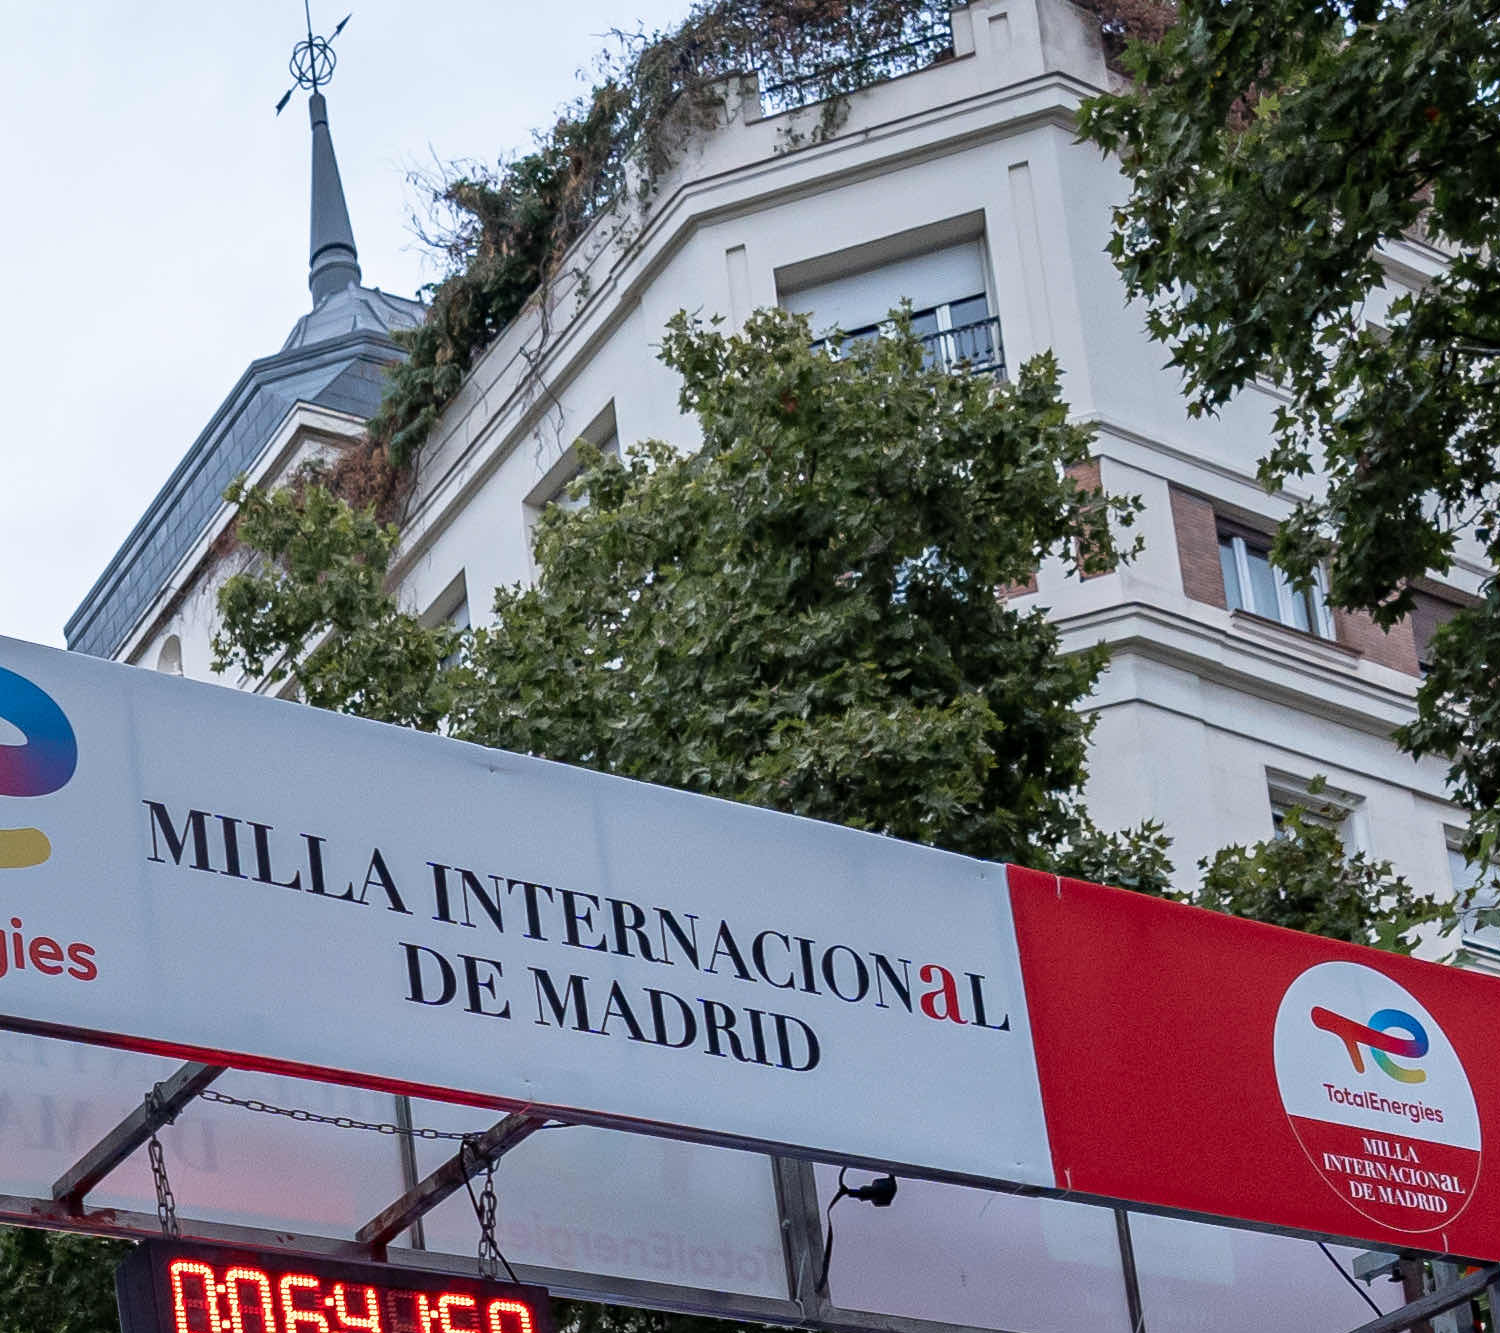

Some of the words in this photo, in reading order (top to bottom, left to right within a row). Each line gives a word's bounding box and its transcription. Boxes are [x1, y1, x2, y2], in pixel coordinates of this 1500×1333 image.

[141, 799, 414, 917] MILLA
[399, 941, 512, 1020] DE
[527, 966, 822, 1074] MADRID
[1322, 1082, 1445, 1124] TotalEnergies
[1361, 1136, 1421, 1164] MILLA
[1349, 1180, 1376, 1201] DE
[1377, 1184, 1449, 1213] MADRID
